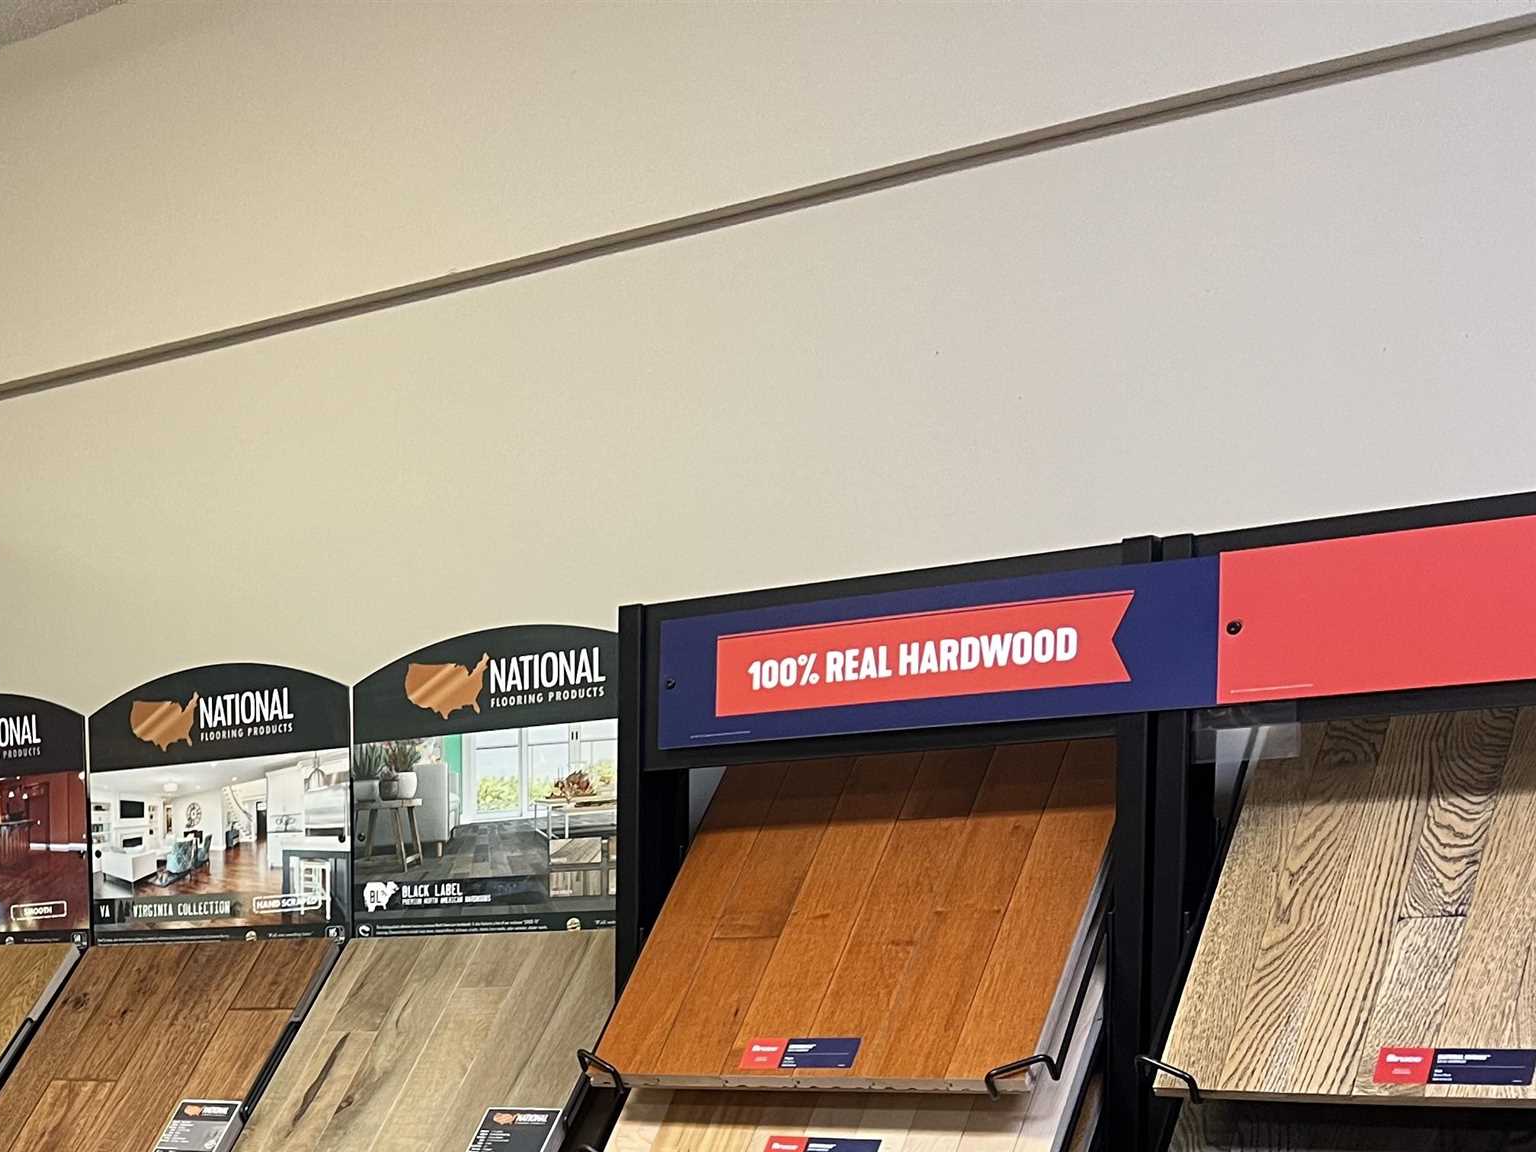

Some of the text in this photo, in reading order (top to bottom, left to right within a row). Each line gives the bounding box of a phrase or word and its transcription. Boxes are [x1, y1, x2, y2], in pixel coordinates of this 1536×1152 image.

[746, 626, 1078, 691] 100% REAL HARDWOOD
[489, 646, 606, 694] NATIONAL
[490, 686, 605, 708] FLOORING PRODUCTS
[198, 686, 294, 729] NATIONAL
[199, 722, 294, 743] FLOORING PRODUCTS
[2, 746, 41, 760] PRODUCTS
[401, 882, 464, 898] BLACK LABEL
[99, 904, 111, 918] VA
[132, 899, 231, 918] VIRGINIA COLLECTION
[1387, 1054, 1422, 1062] Bruce
